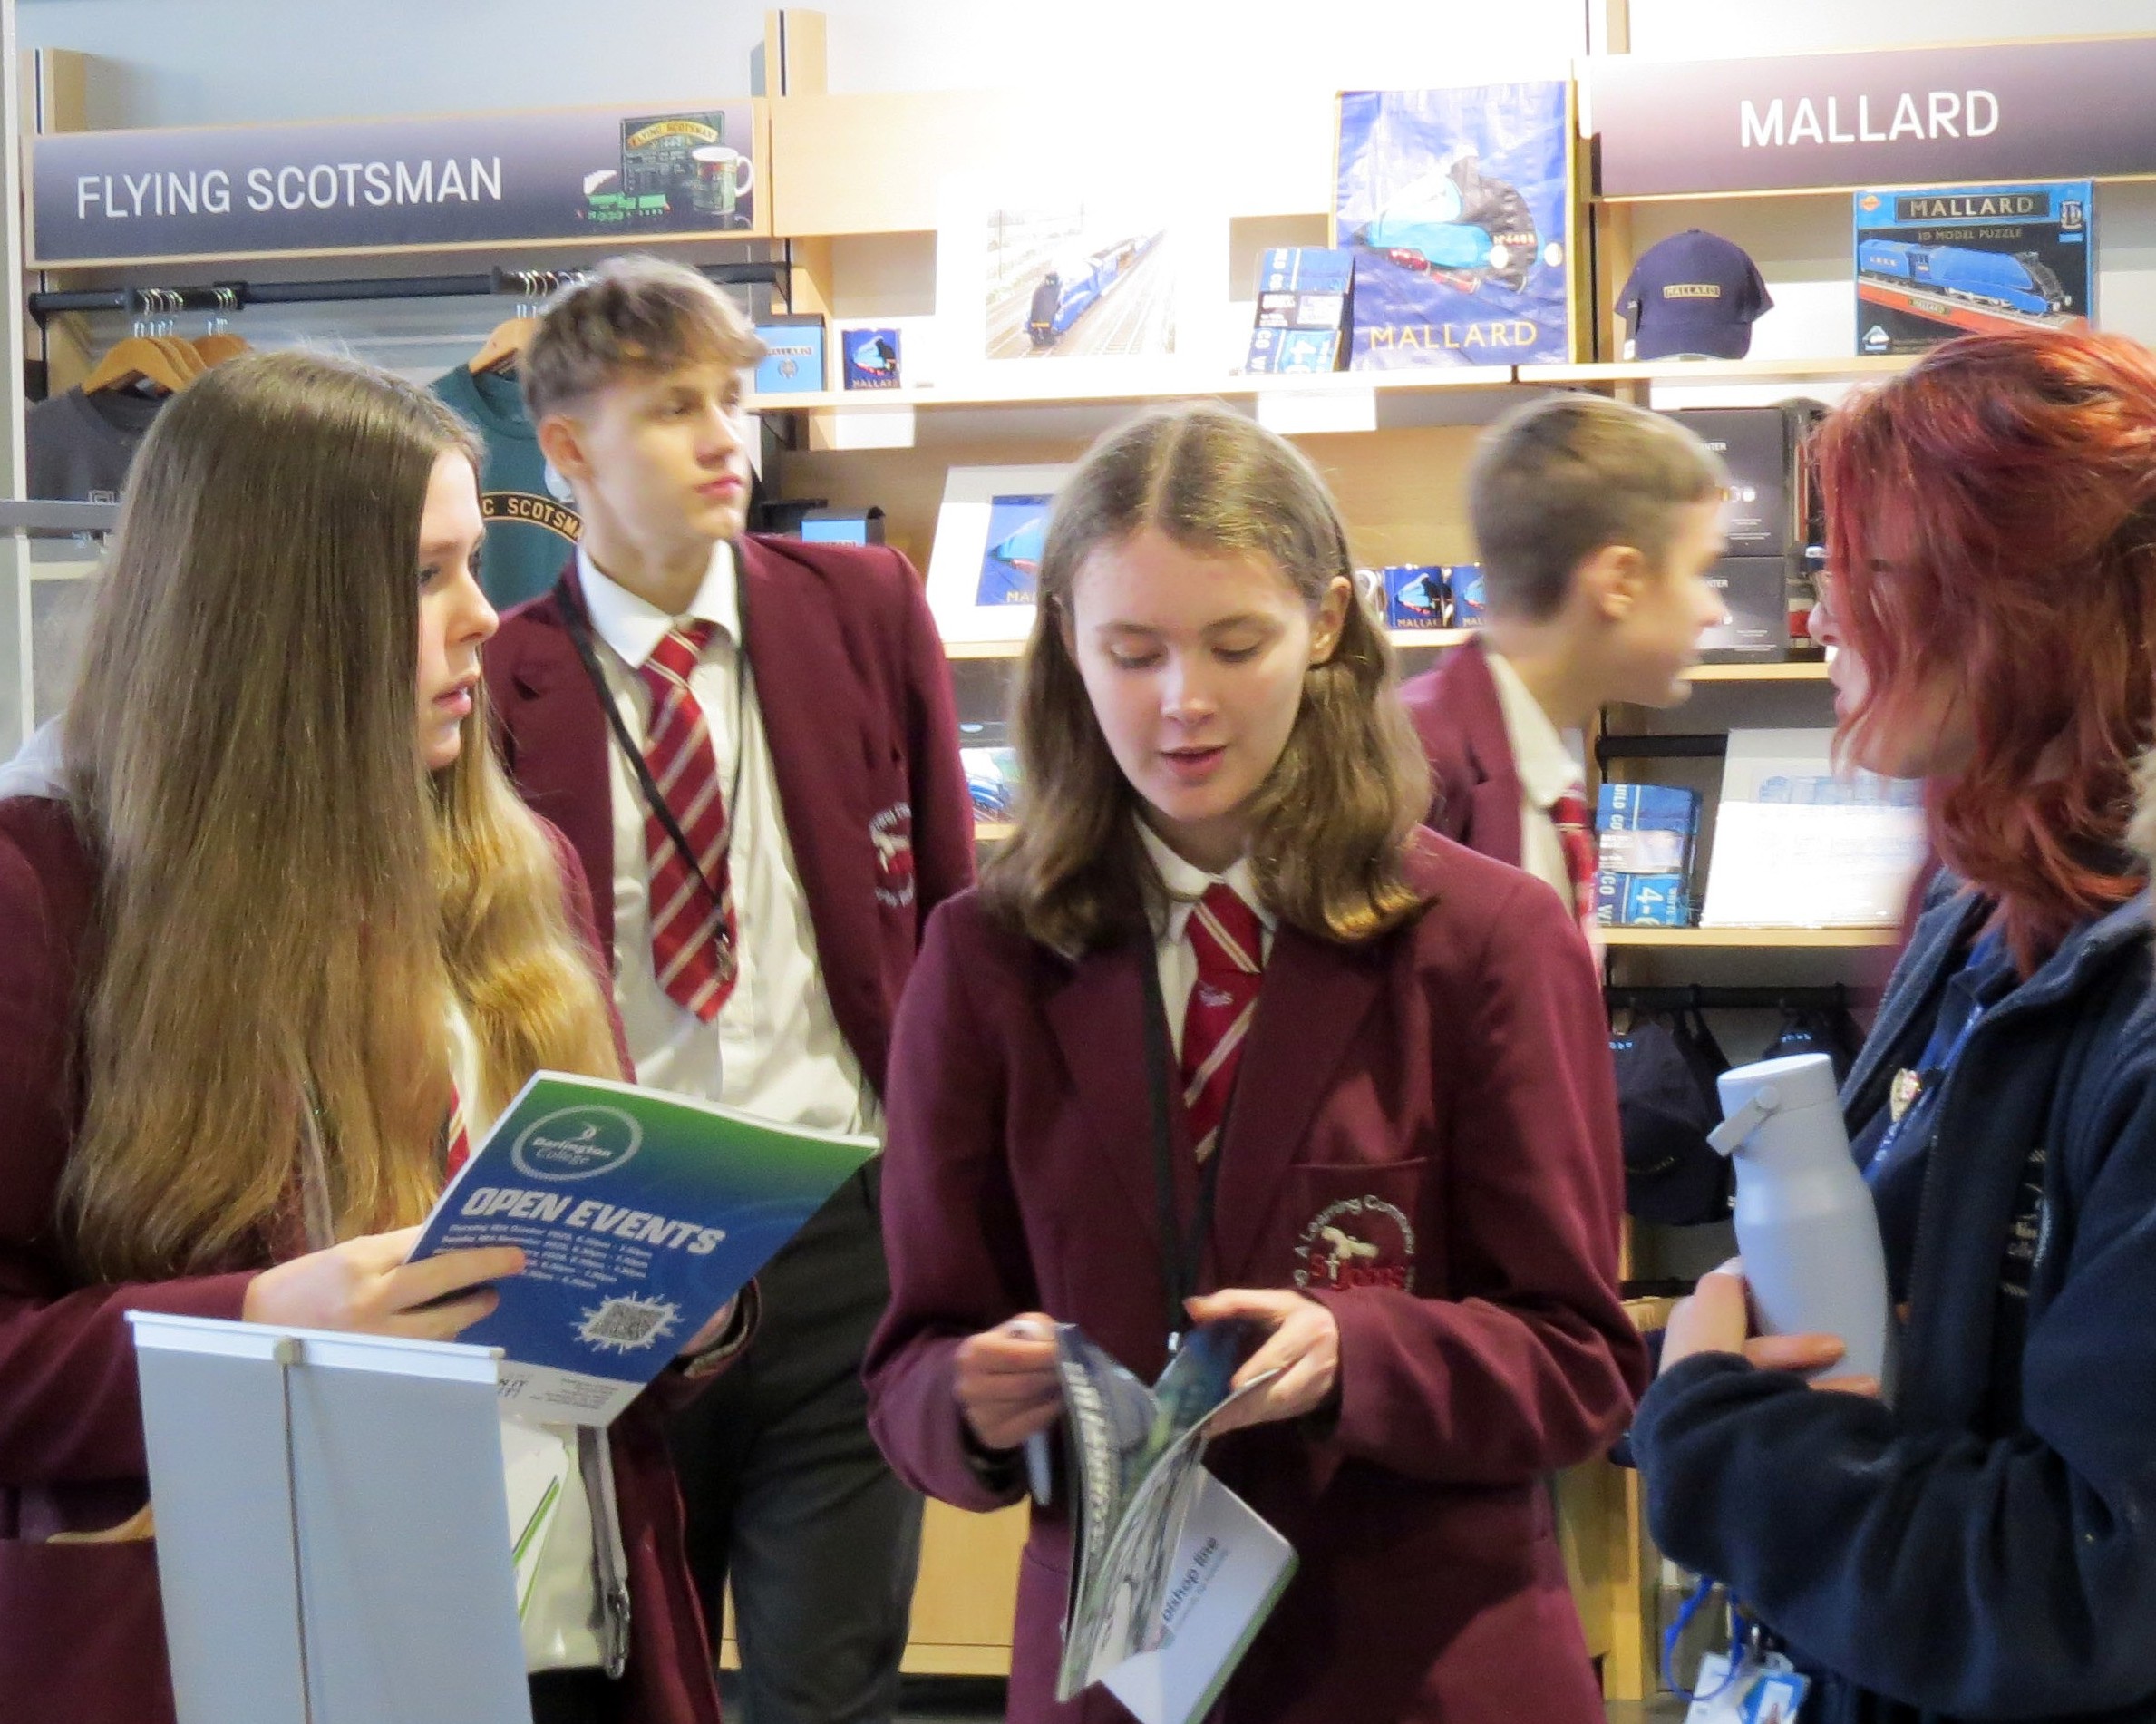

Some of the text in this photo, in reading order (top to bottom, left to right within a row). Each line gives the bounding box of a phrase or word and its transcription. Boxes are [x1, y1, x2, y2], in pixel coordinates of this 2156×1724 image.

[1740, 89, 2000, 148] MALLARD
[76, 156, 502, 219] FLYING SCOTSMAN
[1909, 195, 2034, 218] MALLARD
[1935, 229, 1975, 241] MODEL
[1979, 228, 2023, 239] PUZZLE
[1369, 320, 1538, 351] MALLARD
[532, 1136, 613, 1159] Darlington
[461, 1186, 573, 1222] OPEN
[564, 1199, 726, 1255] EVENTS
